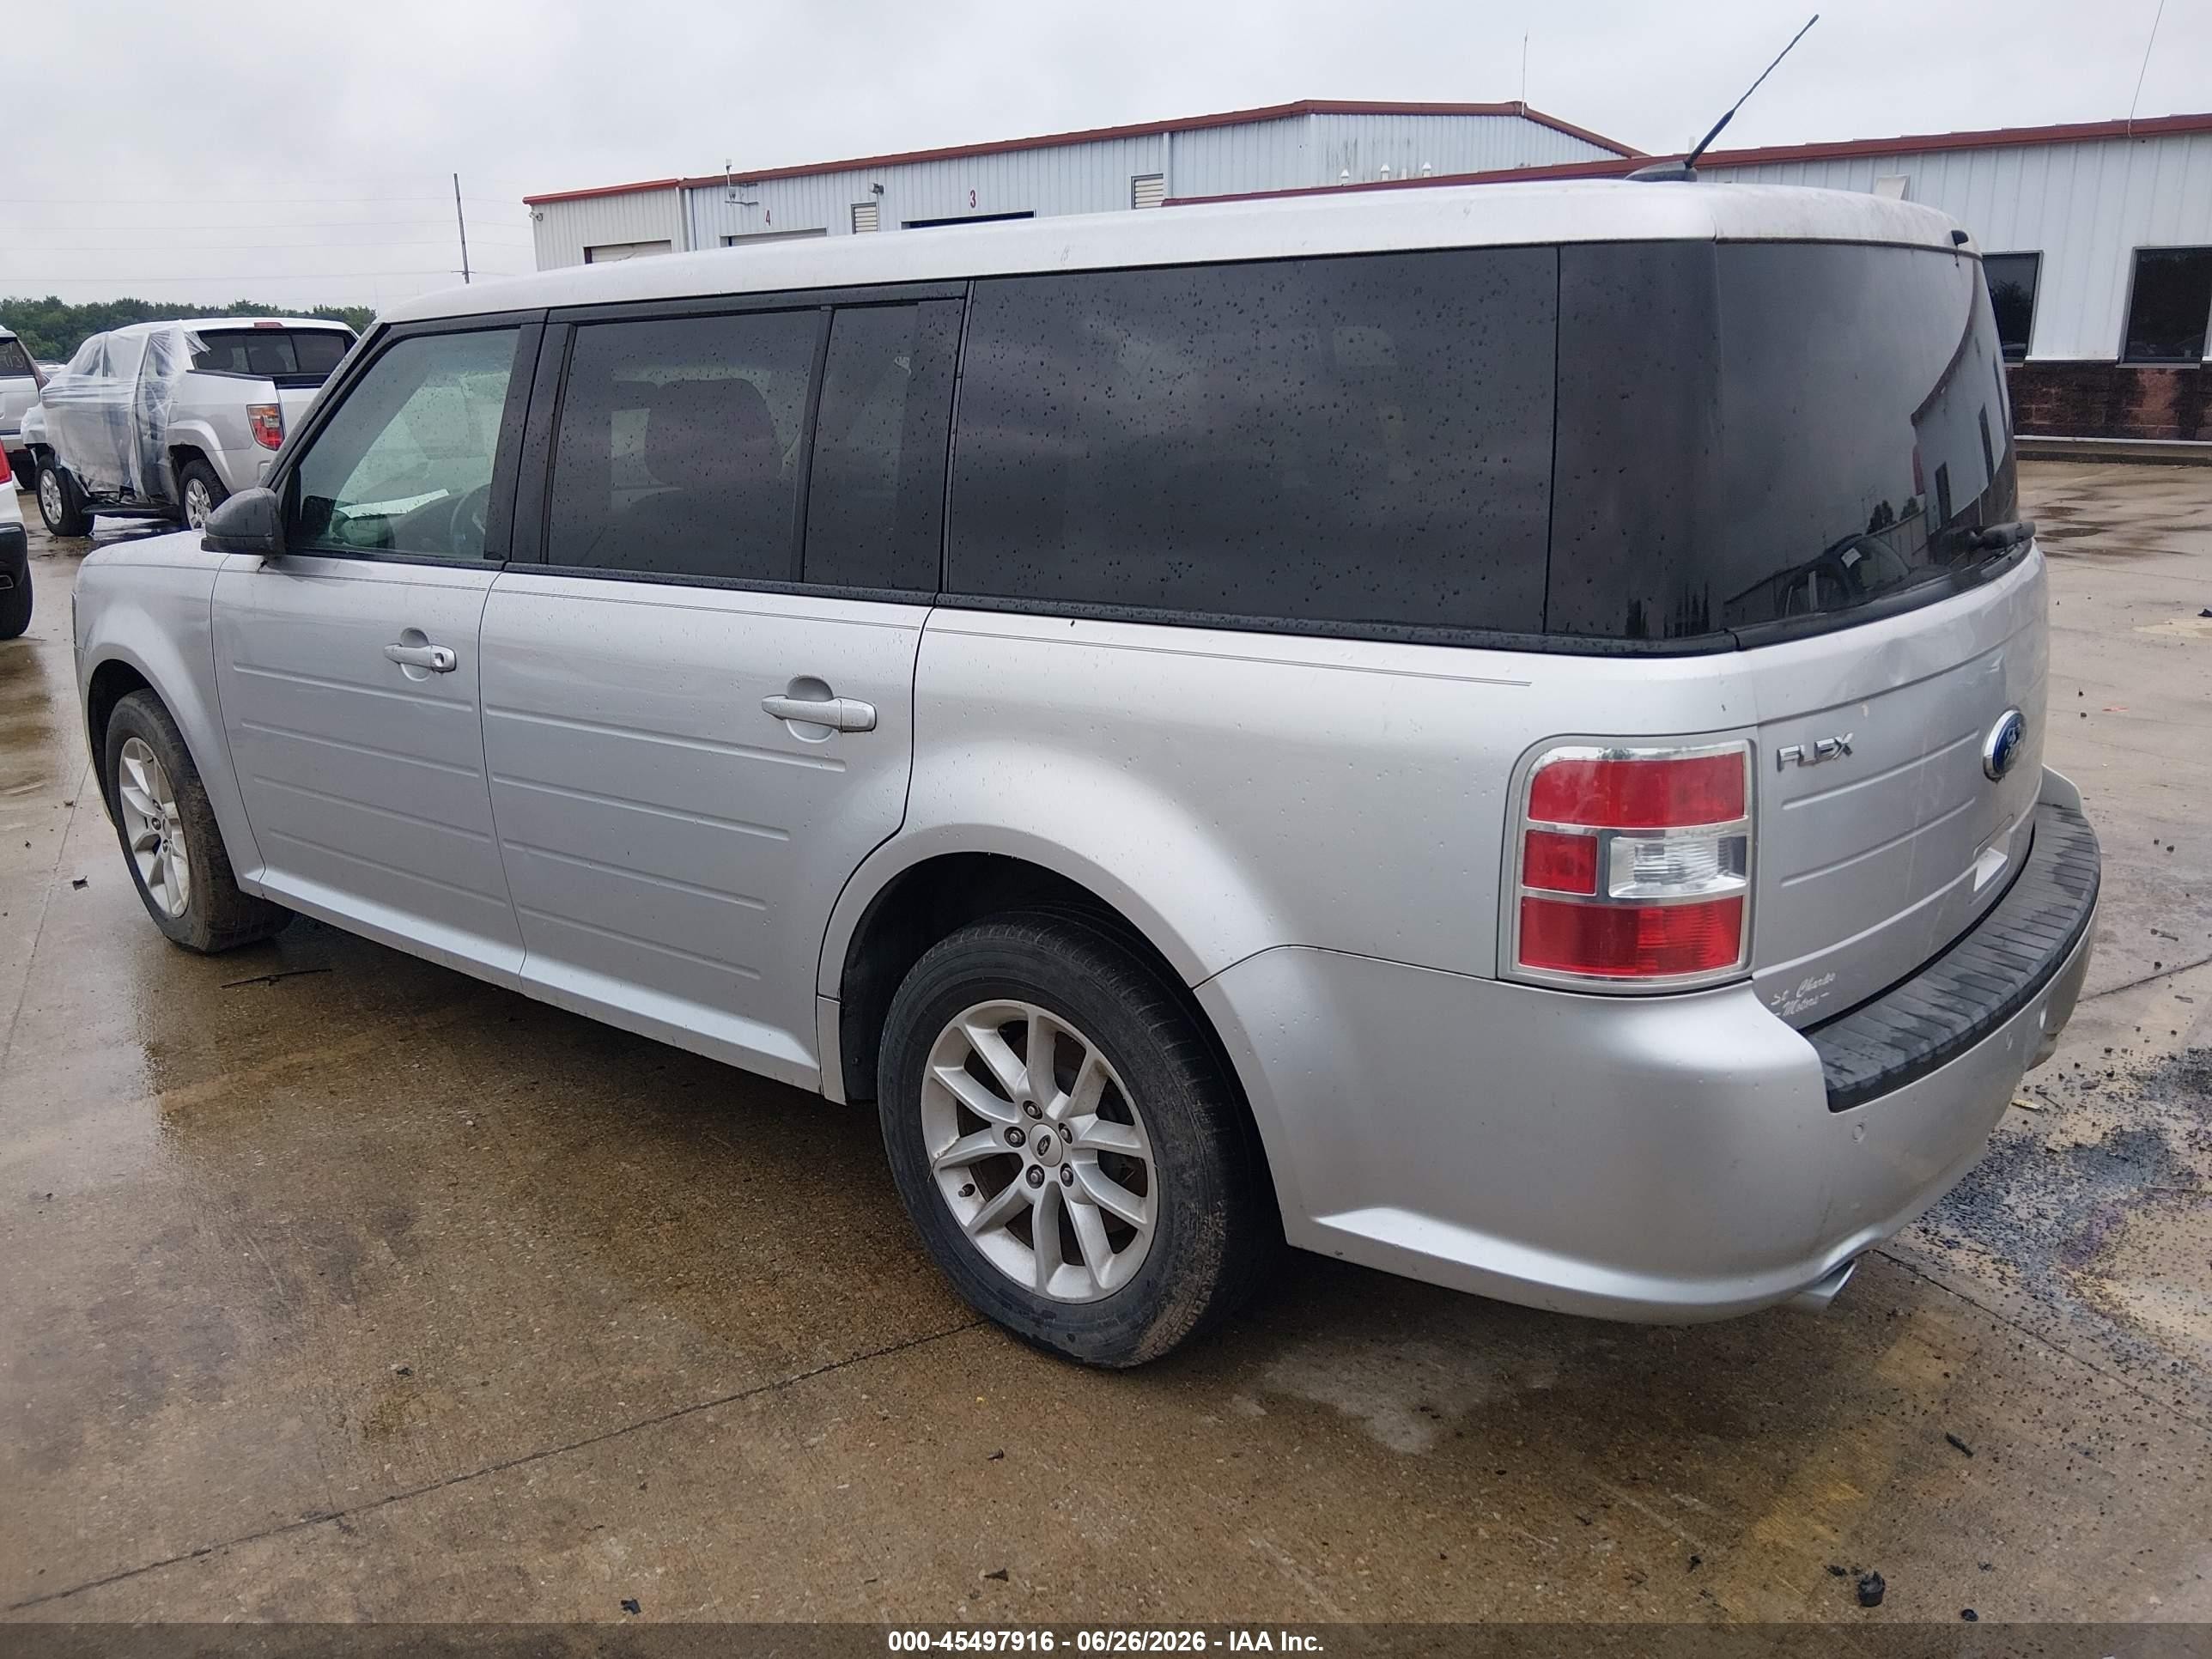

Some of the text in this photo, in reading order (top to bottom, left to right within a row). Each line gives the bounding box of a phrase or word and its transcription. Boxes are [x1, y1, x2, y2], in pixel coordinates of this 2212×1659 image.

[969, 189, 977, 208] 3
[764, 210, 771, 227] 4
[1776, 732, 1854, 773] FLEX
